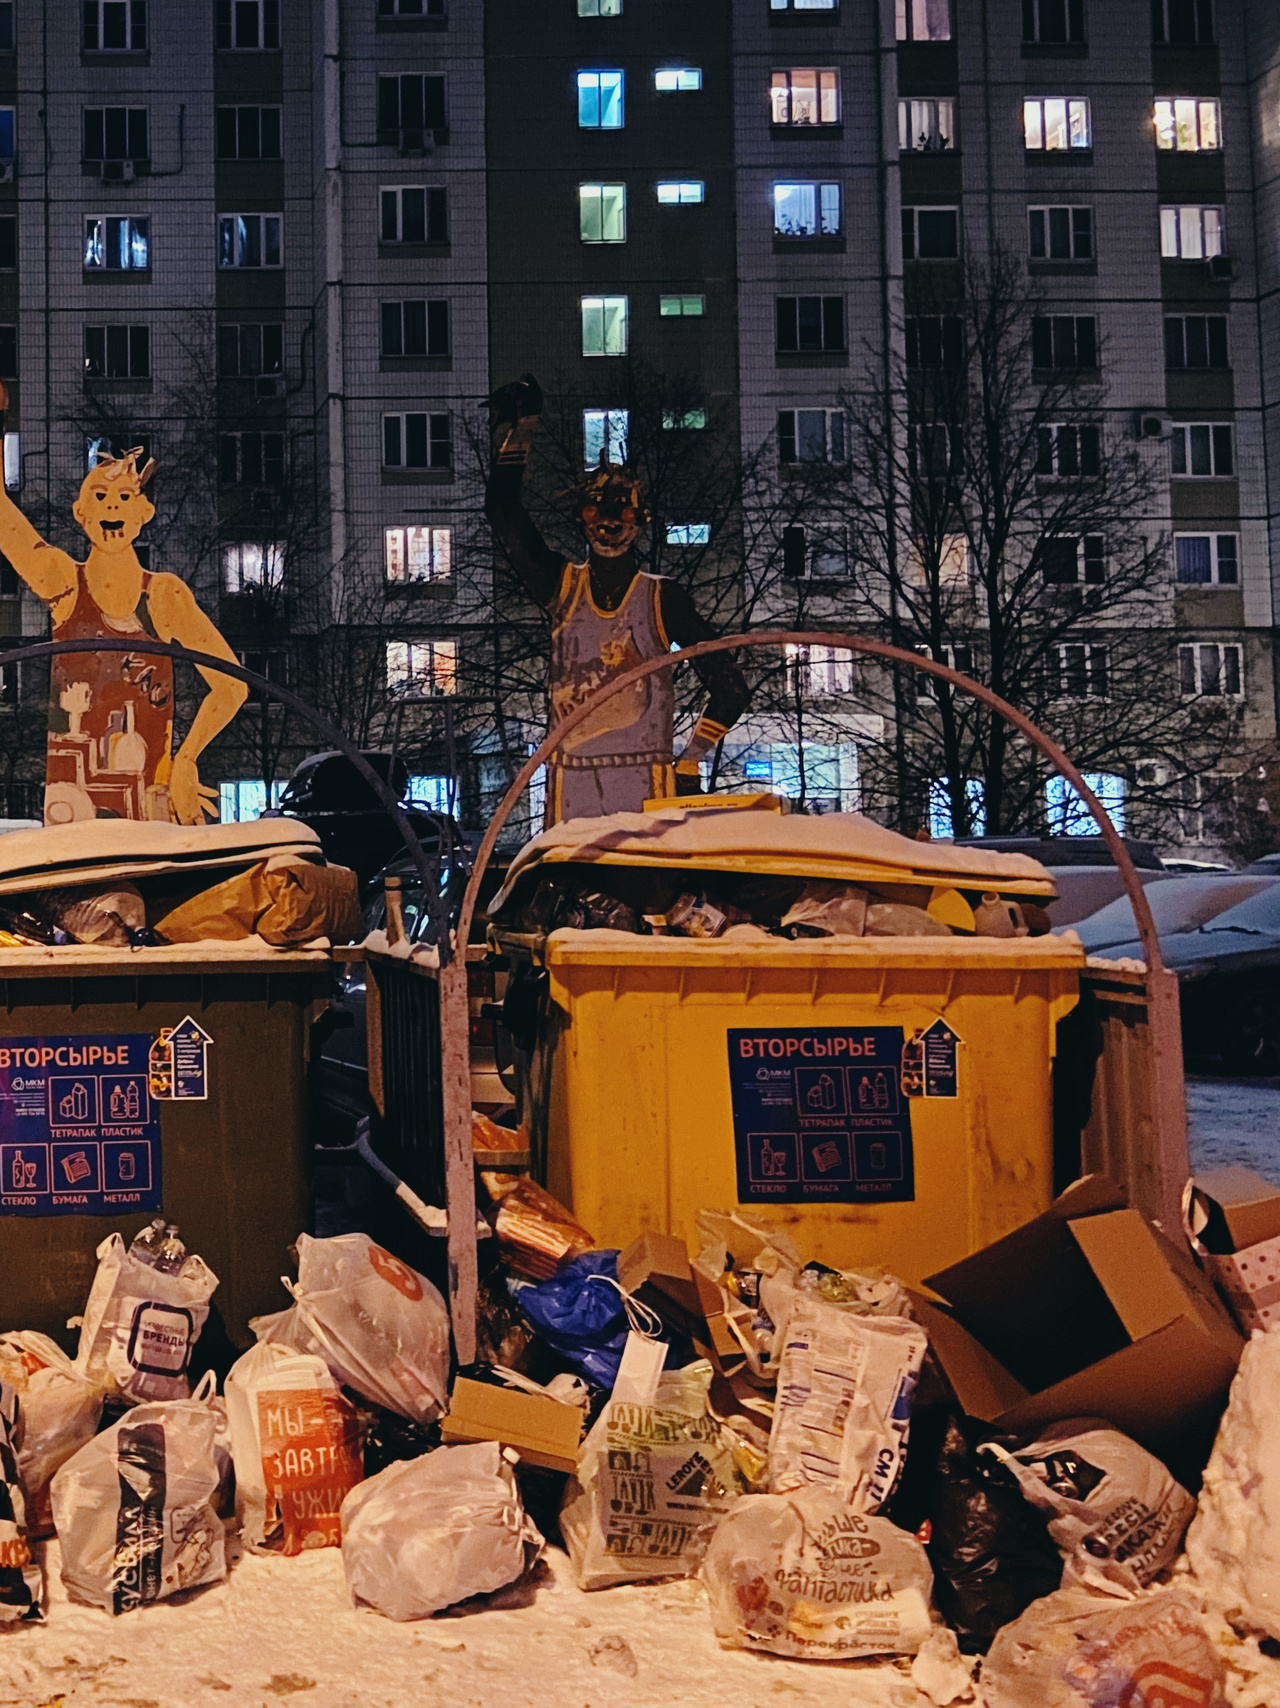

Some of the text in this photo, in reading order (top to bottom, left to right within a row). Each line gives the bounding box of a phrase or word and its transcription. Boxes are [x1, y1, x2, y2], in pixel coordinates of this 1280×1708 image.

[739, 1037, 876, 1058] ВТОРСЫРЬЕ
[799, 1118, 894, 1127] ТЕТРАПАК ПЛАСТИК
[50, 1127, 144, 1138] ТЕТРАПАК ПЛАСТИК
[750, 1183, 892, 1194] СТЕКЛО БУМАГА МЕТАЛЛ
[1, 1194, 140, 1206] СТЕКЛО БУМАГА МЕТАЛЛ
[143, 1330, 185, 1347] БРЕНДЫ
[267, 1407, 304, 1436] МЫ
[665, 1457, 697, 1490] LEROY
[292, 1487, 348, 1519] УЖИ
